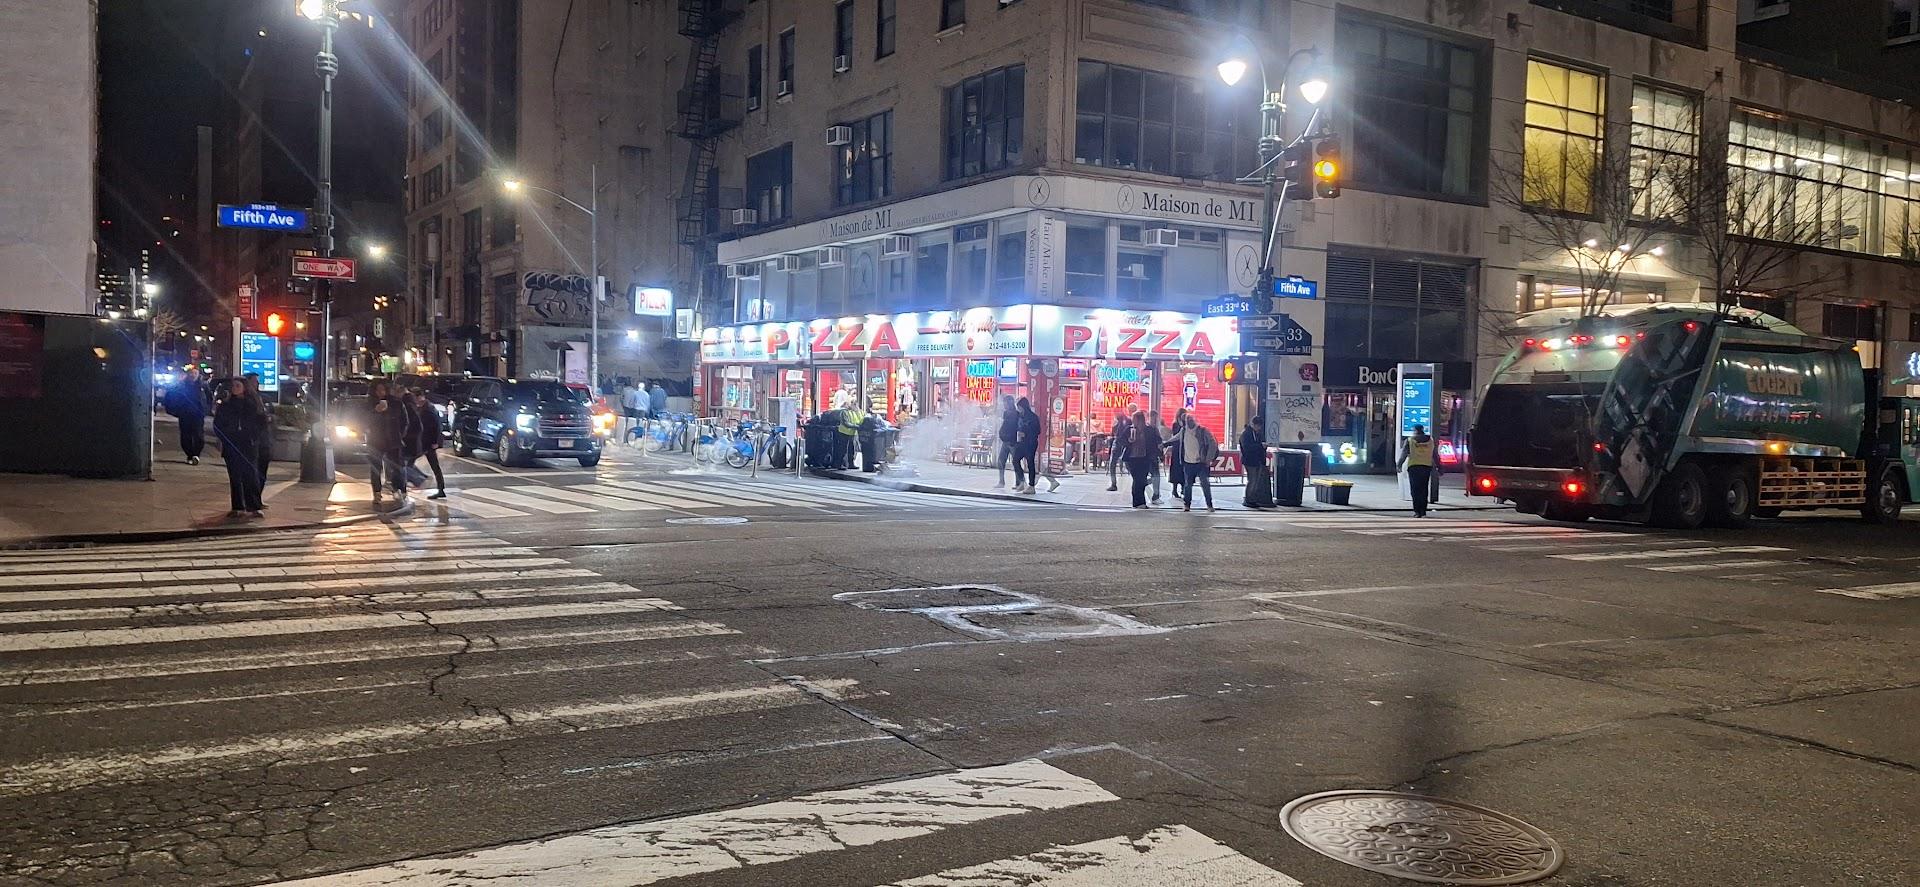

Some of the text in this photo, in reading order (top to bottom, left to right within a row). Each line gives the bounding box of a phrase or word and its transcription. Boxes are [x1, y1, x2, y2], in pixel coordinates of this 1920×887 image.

[1142, 192, 1256, 222] Maison de MI
[233, 210, 295, 226] Fifth Ave
[830, 209, 892, 238] Maison de MI
[302, 262, 346, 273] ONE WAY
[1280, 282, 1311, 295] Fifth Ave
[1207, 301, 1250, 314] East 33rd St
[767, 320, 902, 356] PIZZA
[1063, 324, 1216, 356] PIZZA
[1287, 328, 1303, 341] 33
[930, 343, 954, 351] DELIVERY
[989, 341, 1026, 350] 212-481-5200
[1099, 367, 1139, 381] COLDEST
[1097, 382, 1141, 394] DRAFT BEER
[1103, 395, 1112, 408] IN
